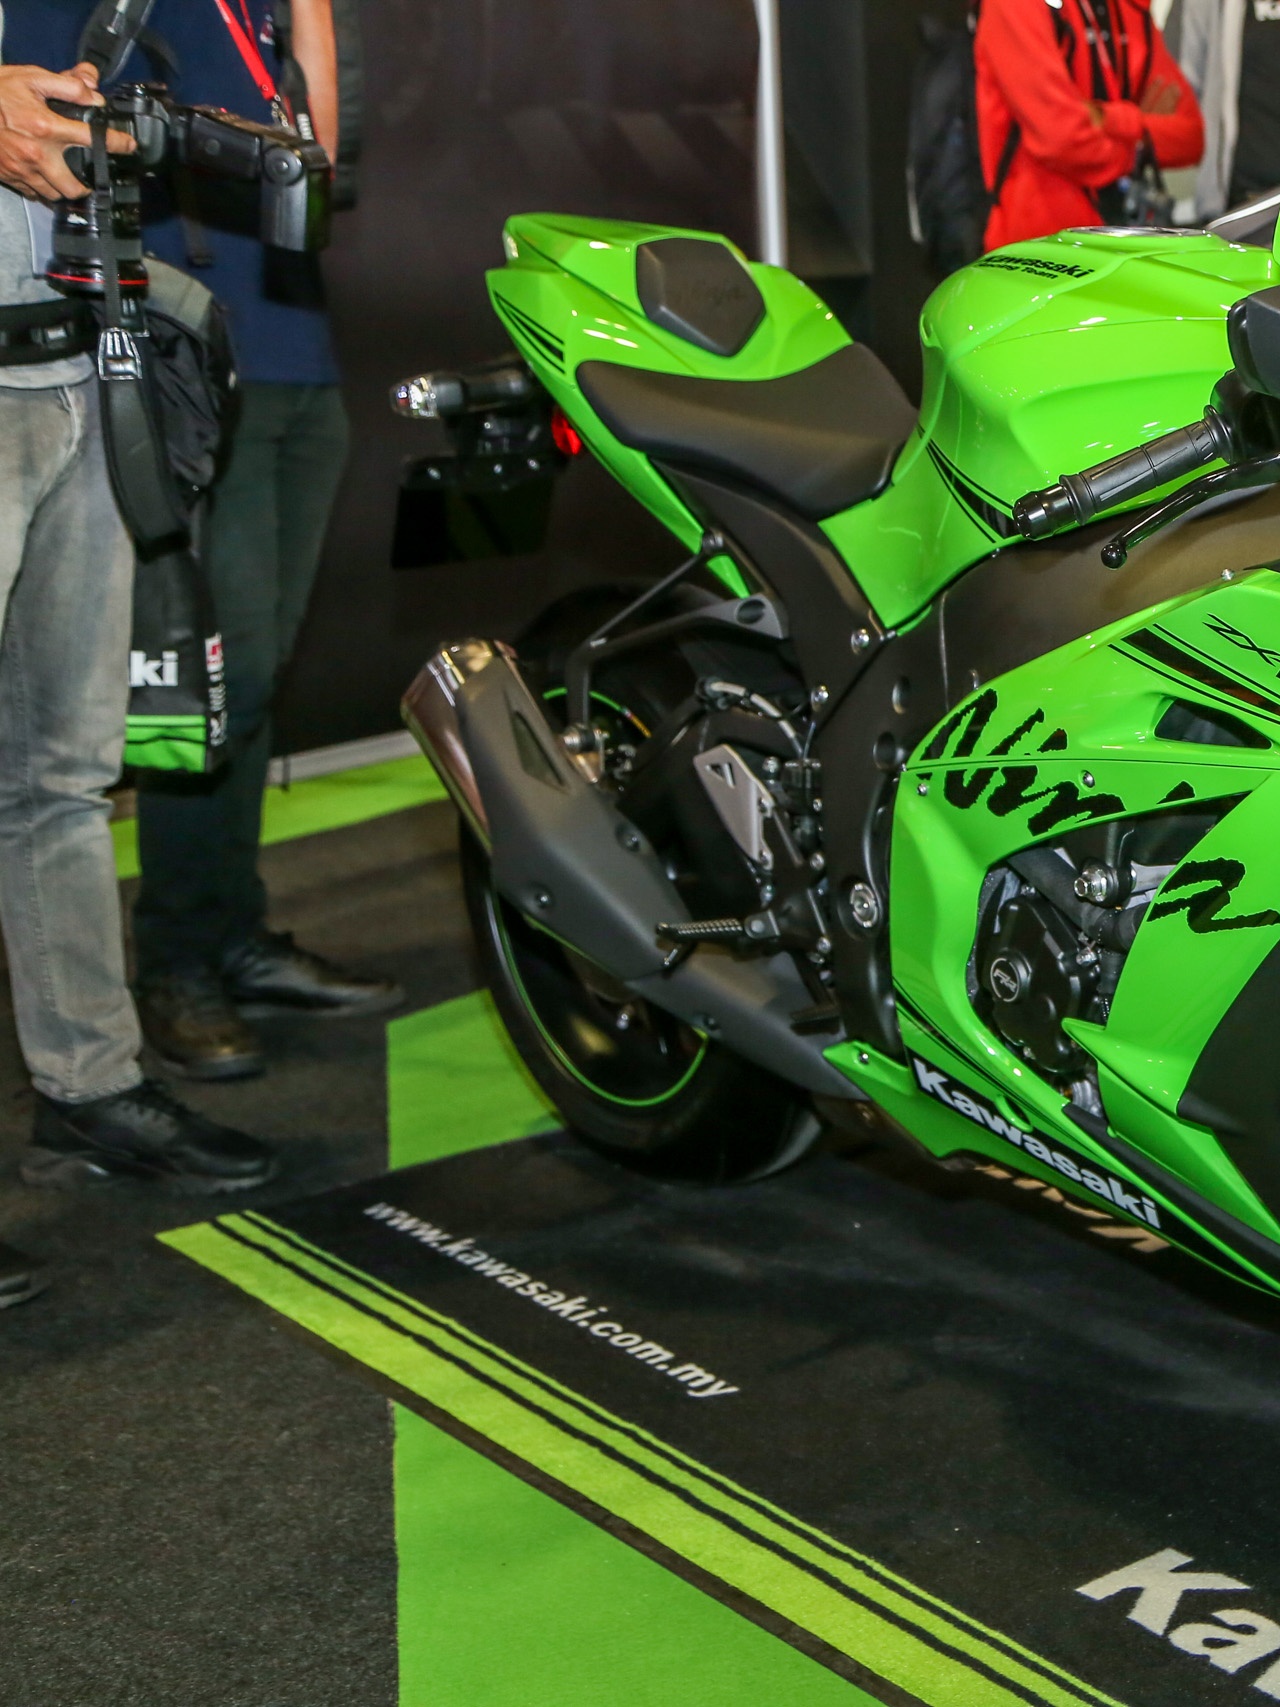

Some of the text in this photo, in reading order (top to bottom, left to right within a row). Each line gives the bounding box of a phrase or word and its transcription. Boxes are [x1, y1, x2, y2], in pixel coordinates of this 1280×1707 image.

[981, 255, 1095, 278] Kawasaki
[1021, 266, 1058, 279] Team
[913, 1057, 1161, 1230] Kawasaki
[363, 1201, 741, 1398] www.kawasaki.com.my
